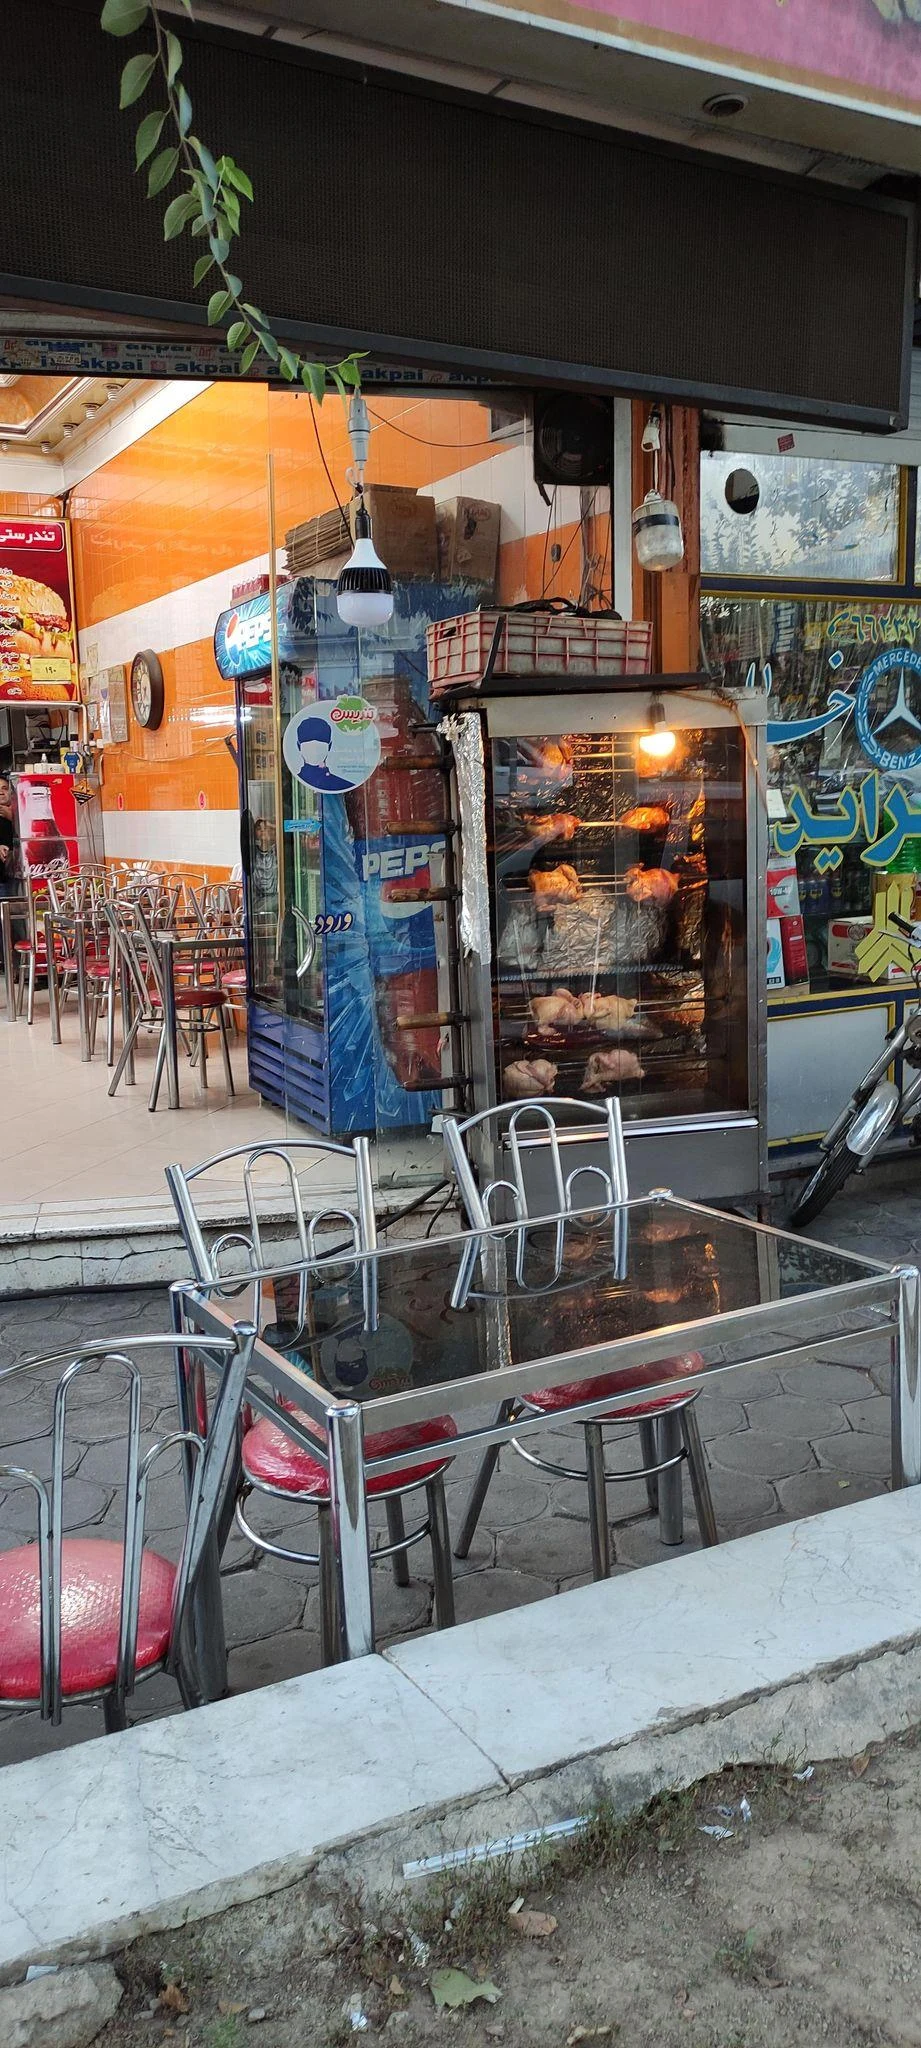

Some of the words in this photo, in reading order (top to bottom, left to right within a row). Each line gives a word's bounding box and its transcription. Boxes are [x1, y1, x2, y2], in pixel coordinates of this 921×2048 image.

[879, 750, 921, 770] BENZ
[773, 768, 921, 876] راید
[314, 911, 354, 936] ورود
